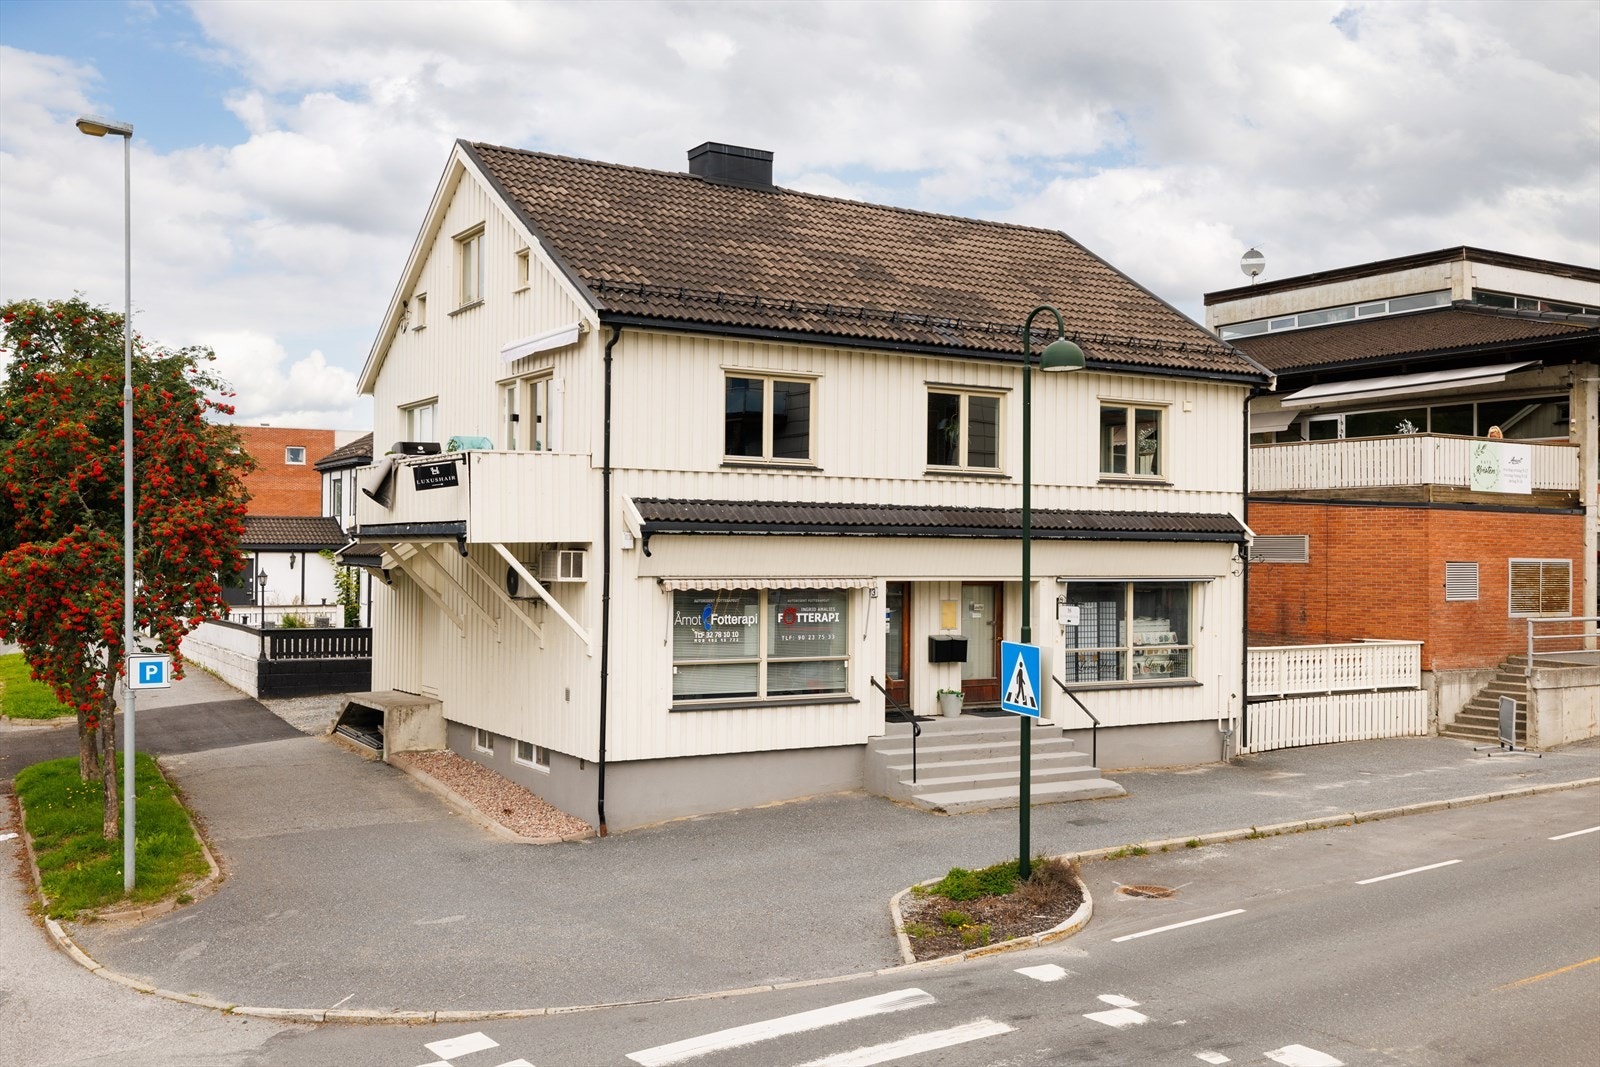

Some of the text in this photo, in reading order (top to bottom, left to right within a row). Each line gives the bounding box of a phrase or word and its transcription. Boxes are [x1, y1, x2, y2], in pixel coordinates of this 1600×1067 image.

[416, 476, 456, 484] LUXUSHAIR
[674, 611, 758, 627] Åmot Fotterapi
[778, 609, 840, 624] FOTTERAPI
[146, 665, 158, 680] P
